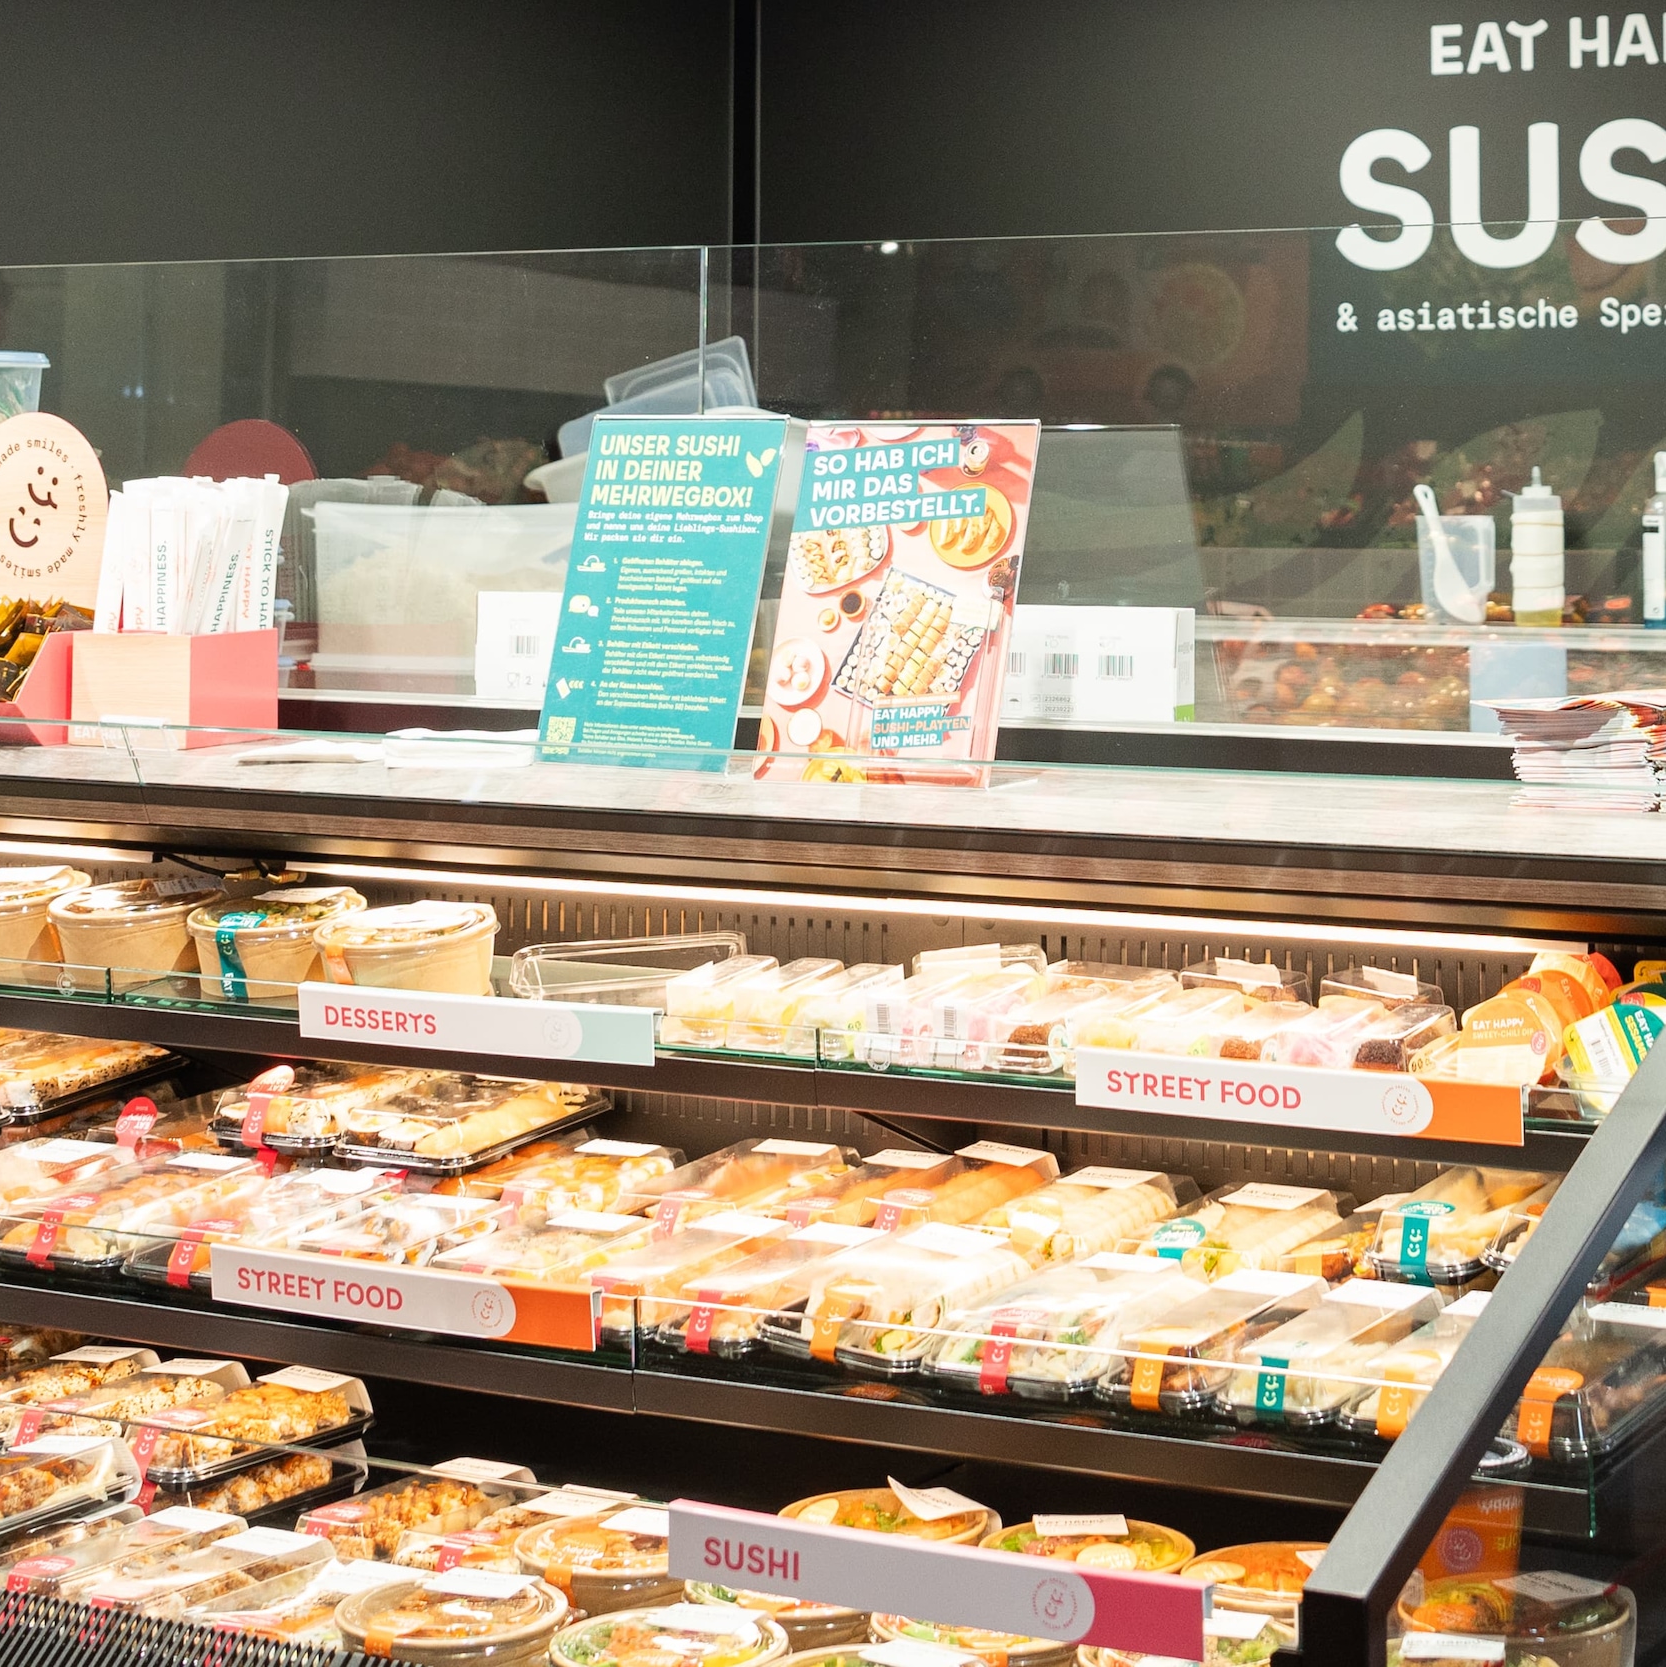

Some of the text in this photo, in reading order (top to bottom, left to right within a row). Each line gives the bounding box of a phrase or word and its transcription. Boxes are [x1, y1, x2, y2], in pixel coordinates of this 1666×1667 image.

[1430, 19, 1549, 75] EAT
[1336, 304, 1359, 332] &
[1377, 297, 1578, 330] asiatische
[26, 437, 69, 464] smiles
[600, 434, 741, 457] UNSER SUSHI
[595, 460, 703, 482] IN DEINER
[813, 443, 954, 476] SO HAB ICH
[590, 484, 754, 508] MEHRWEGBOX!
[812, 473, 913, 502] MIR DAS
[618, 511, 642, 520] deine
[744, 513, 764, 524] Shop
[810, 493, 981, 528] VORBESTELLT.
[586, 522, 601, 530] und
[647, 523, 671, 532] deine
[0, 554, 42, 579] smiles
[47, 547, 74, 574] made
[156, 540, 168, 626] HAPPINESS.
[874, 706, 941, 721] EAT HAPPY
[874, 717, 971, 734] SUSHI-PLATTEN
[872, 733, 941, 748] UND MEHR.
[324, 1005, 437, 1035] DESSERTS
[1472, 1017, 1524, 1030] EAT HAPPY
[1107, 1070, 1302, 1110] STREET FOOD
[237, 1267, 404, 1311] STREET FOOD
[703, 1536, 801, 1583] SUSHI
